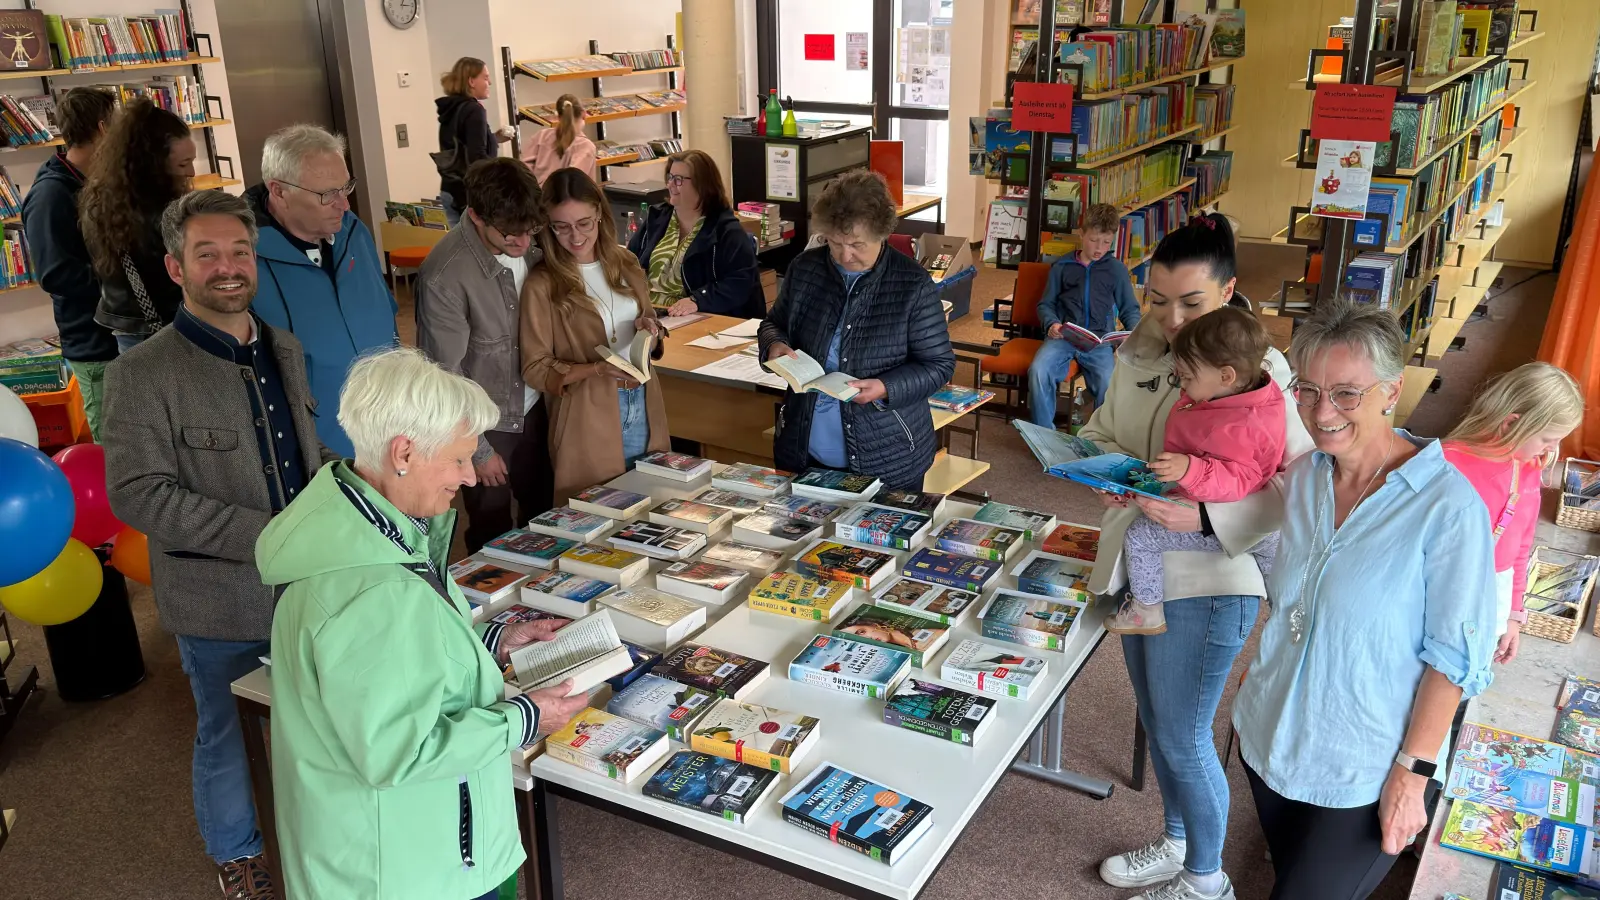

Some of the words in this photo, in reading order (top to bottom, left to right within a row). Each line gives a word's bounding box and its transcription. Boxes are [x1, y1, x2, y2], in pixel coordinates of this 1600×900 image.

[1019, 100, 1044, 108] Ausleihe
[1029, 111, 1055, 119] Dienstag
[870, 530, 886, 540] LAND
[779, 579, 802, 593] FIXER
[793, 582, 819, 597] UPPER
[958, 640, 976, 653] ZEH
[667, 648, 695, 666] ROTH
[985, 684, 1000, 693] ZEH
[940, 696, 966, 719] TOTEN-
[949, 694, 980, 725] GEDENKEN
[900, 715, 946, 732] TOTENGEDENKEN
[668, 756, 708, 791] MEISTER
[804, 787, 828, 806] WENN
[825, 776, 841, 787] DIE
[815, 780, 852, 811] KRANICHE
[821, 801, 845, 819] NACH
[840, 780, 867, 800] SÜDEN
[1552, 782, 1566, 814] Bildermaus
[841, 793, 868, 815] ZIEHEN
[1555, 829, 1570, 861] Leselöwen
